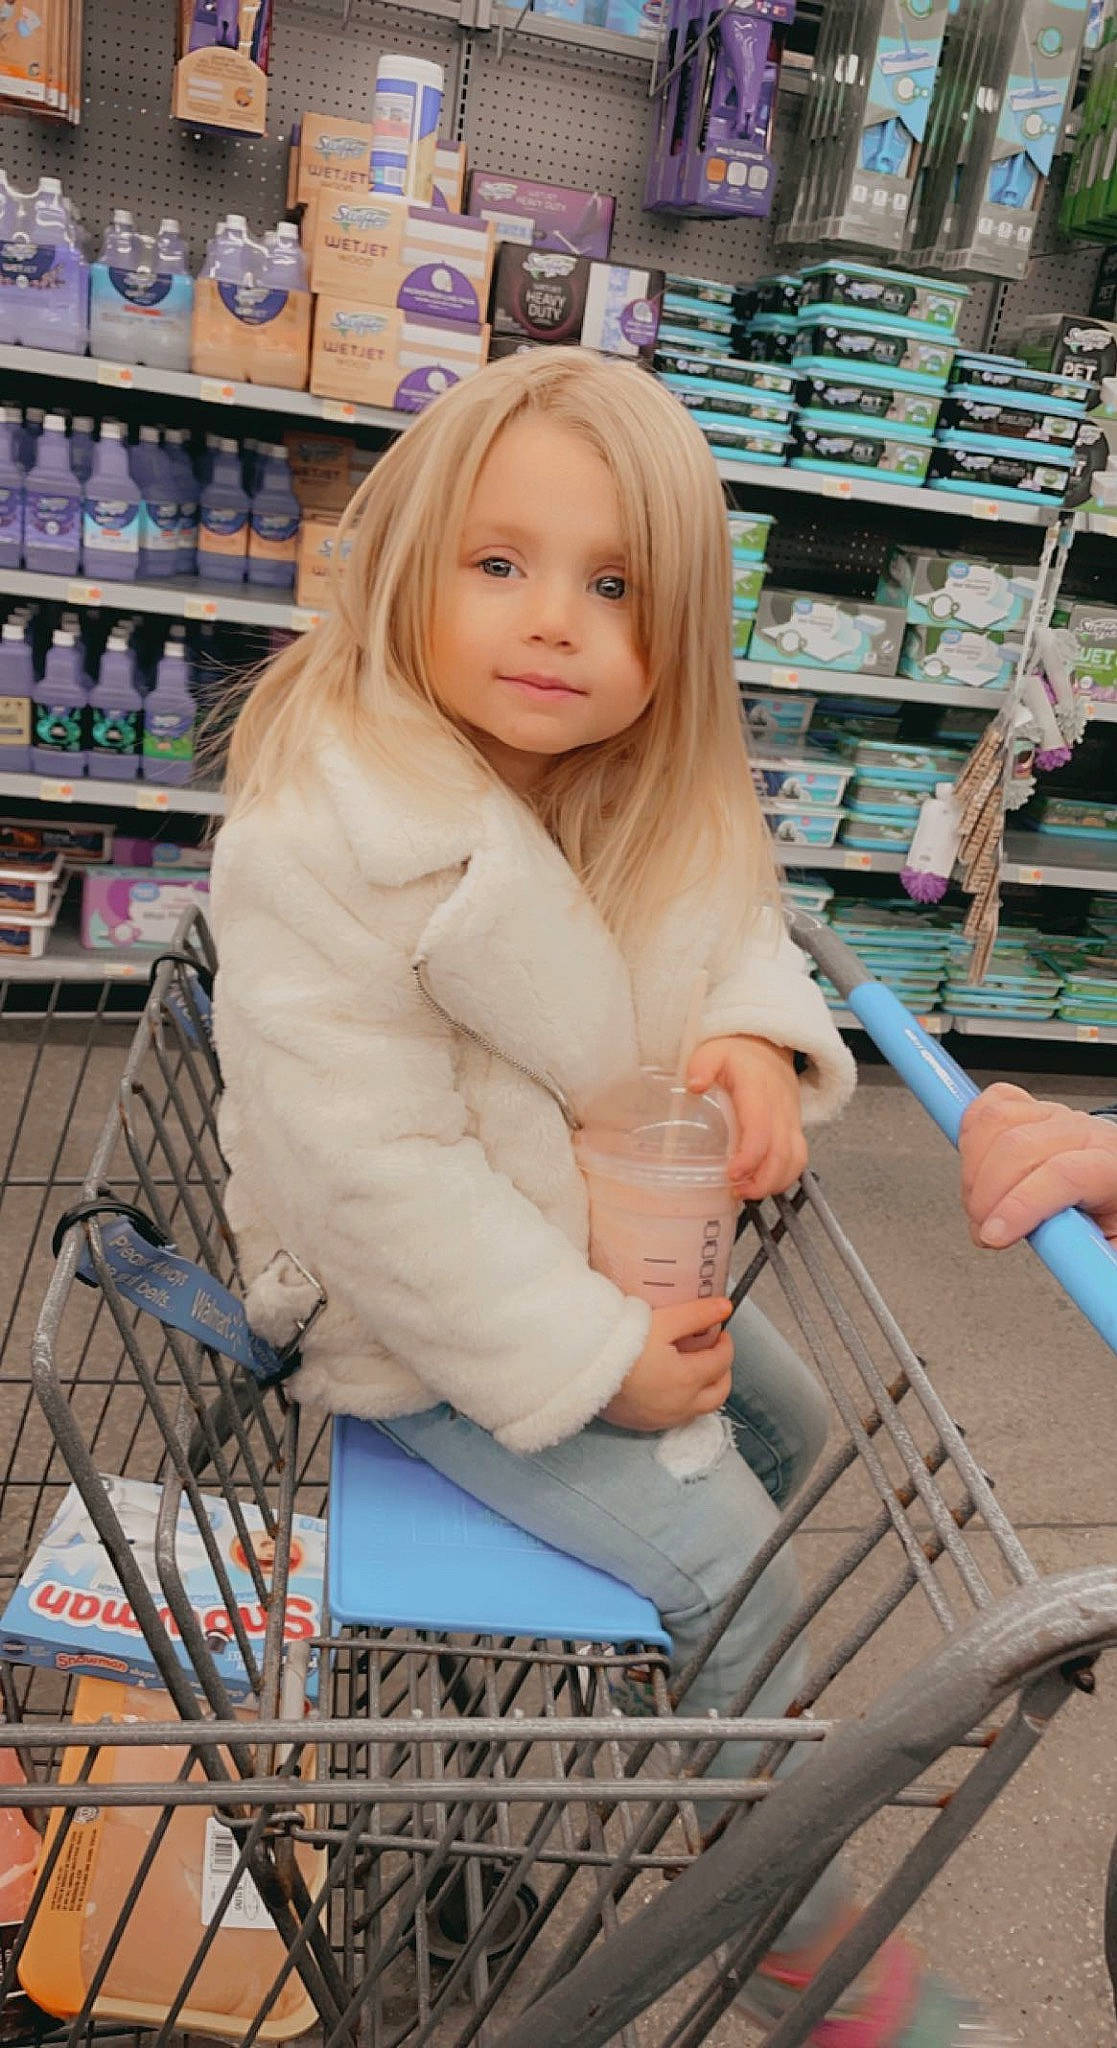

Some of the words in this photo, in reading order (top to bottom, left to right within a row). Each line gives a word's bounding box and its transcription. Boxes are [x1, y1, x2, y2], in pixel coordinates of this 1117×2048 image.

[308, 165, 368, 184] WETJET
[324, 235, 388, 257] WETJET
[323, 341, 385, 361] WETJET
